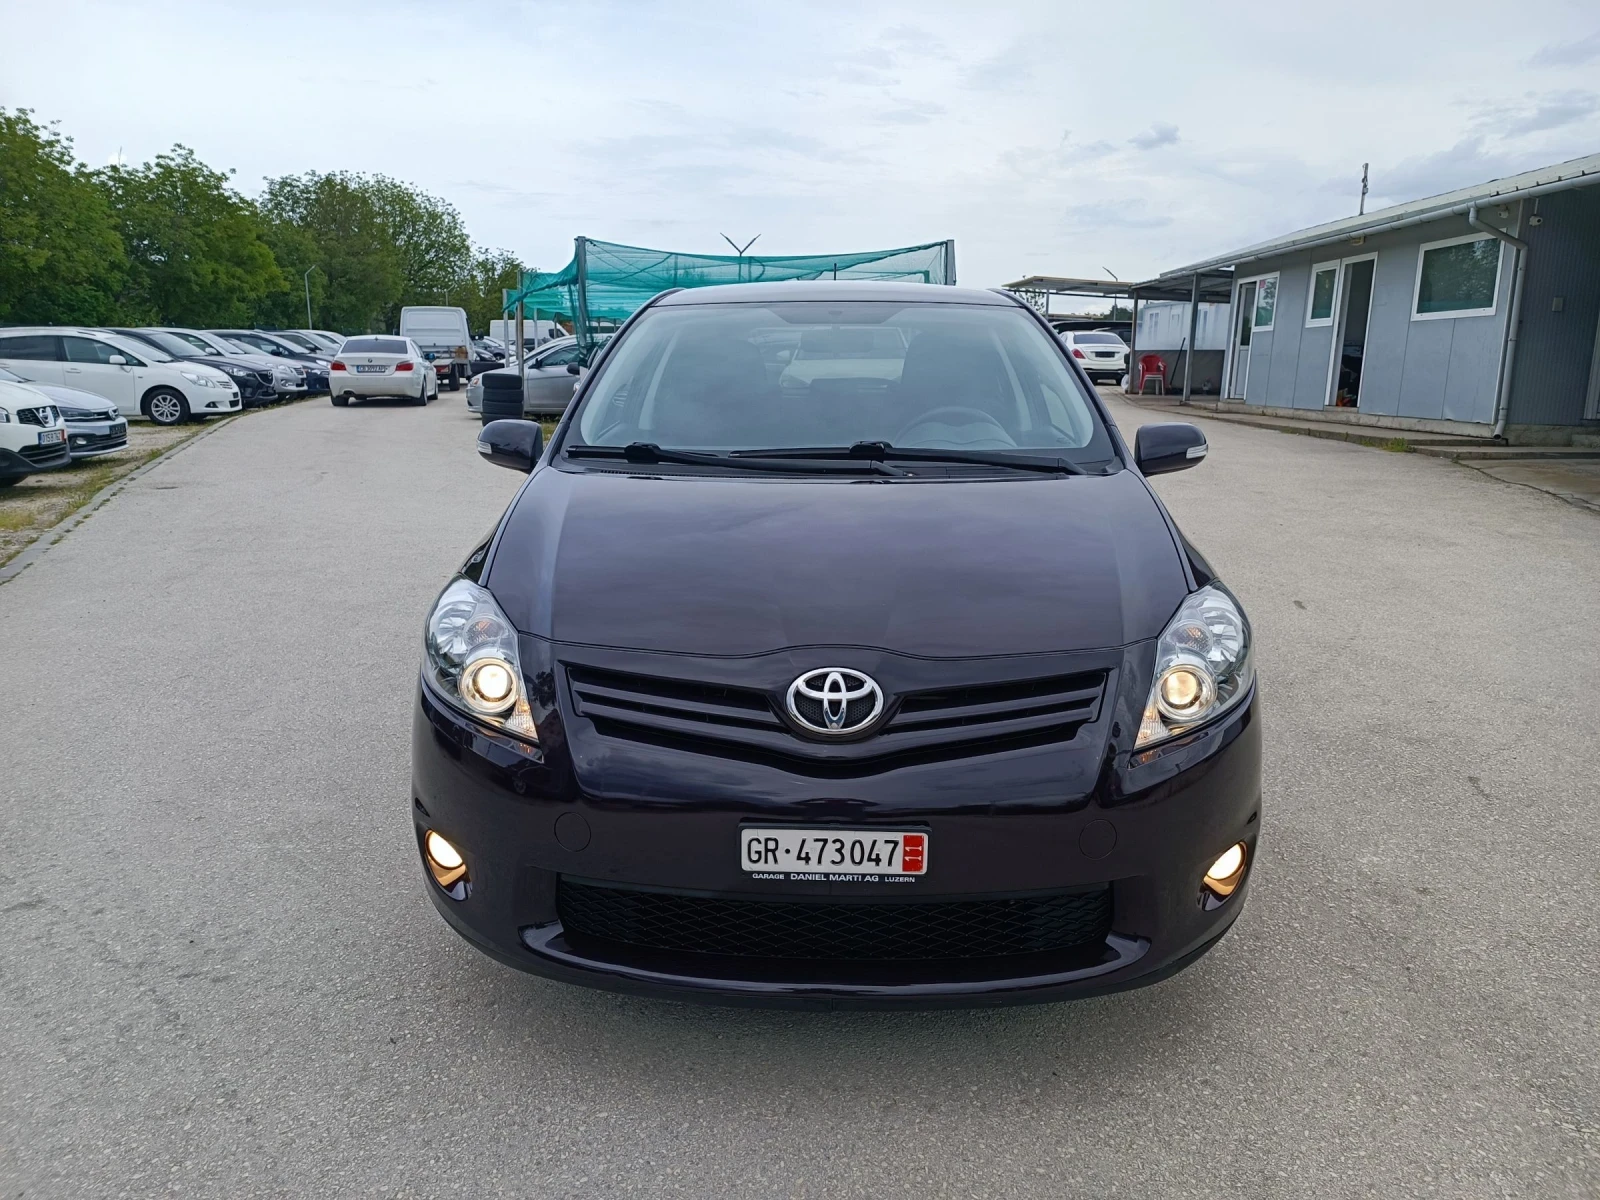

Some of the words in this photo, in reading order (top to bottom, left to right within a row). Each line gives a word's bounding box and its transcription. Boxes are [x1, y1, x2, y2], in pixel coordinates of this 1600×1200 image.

[790, 873, 827, 881] DANIEL
[829, 874, 862, 882] MARTI
[863, 874, 879, 882] AG
